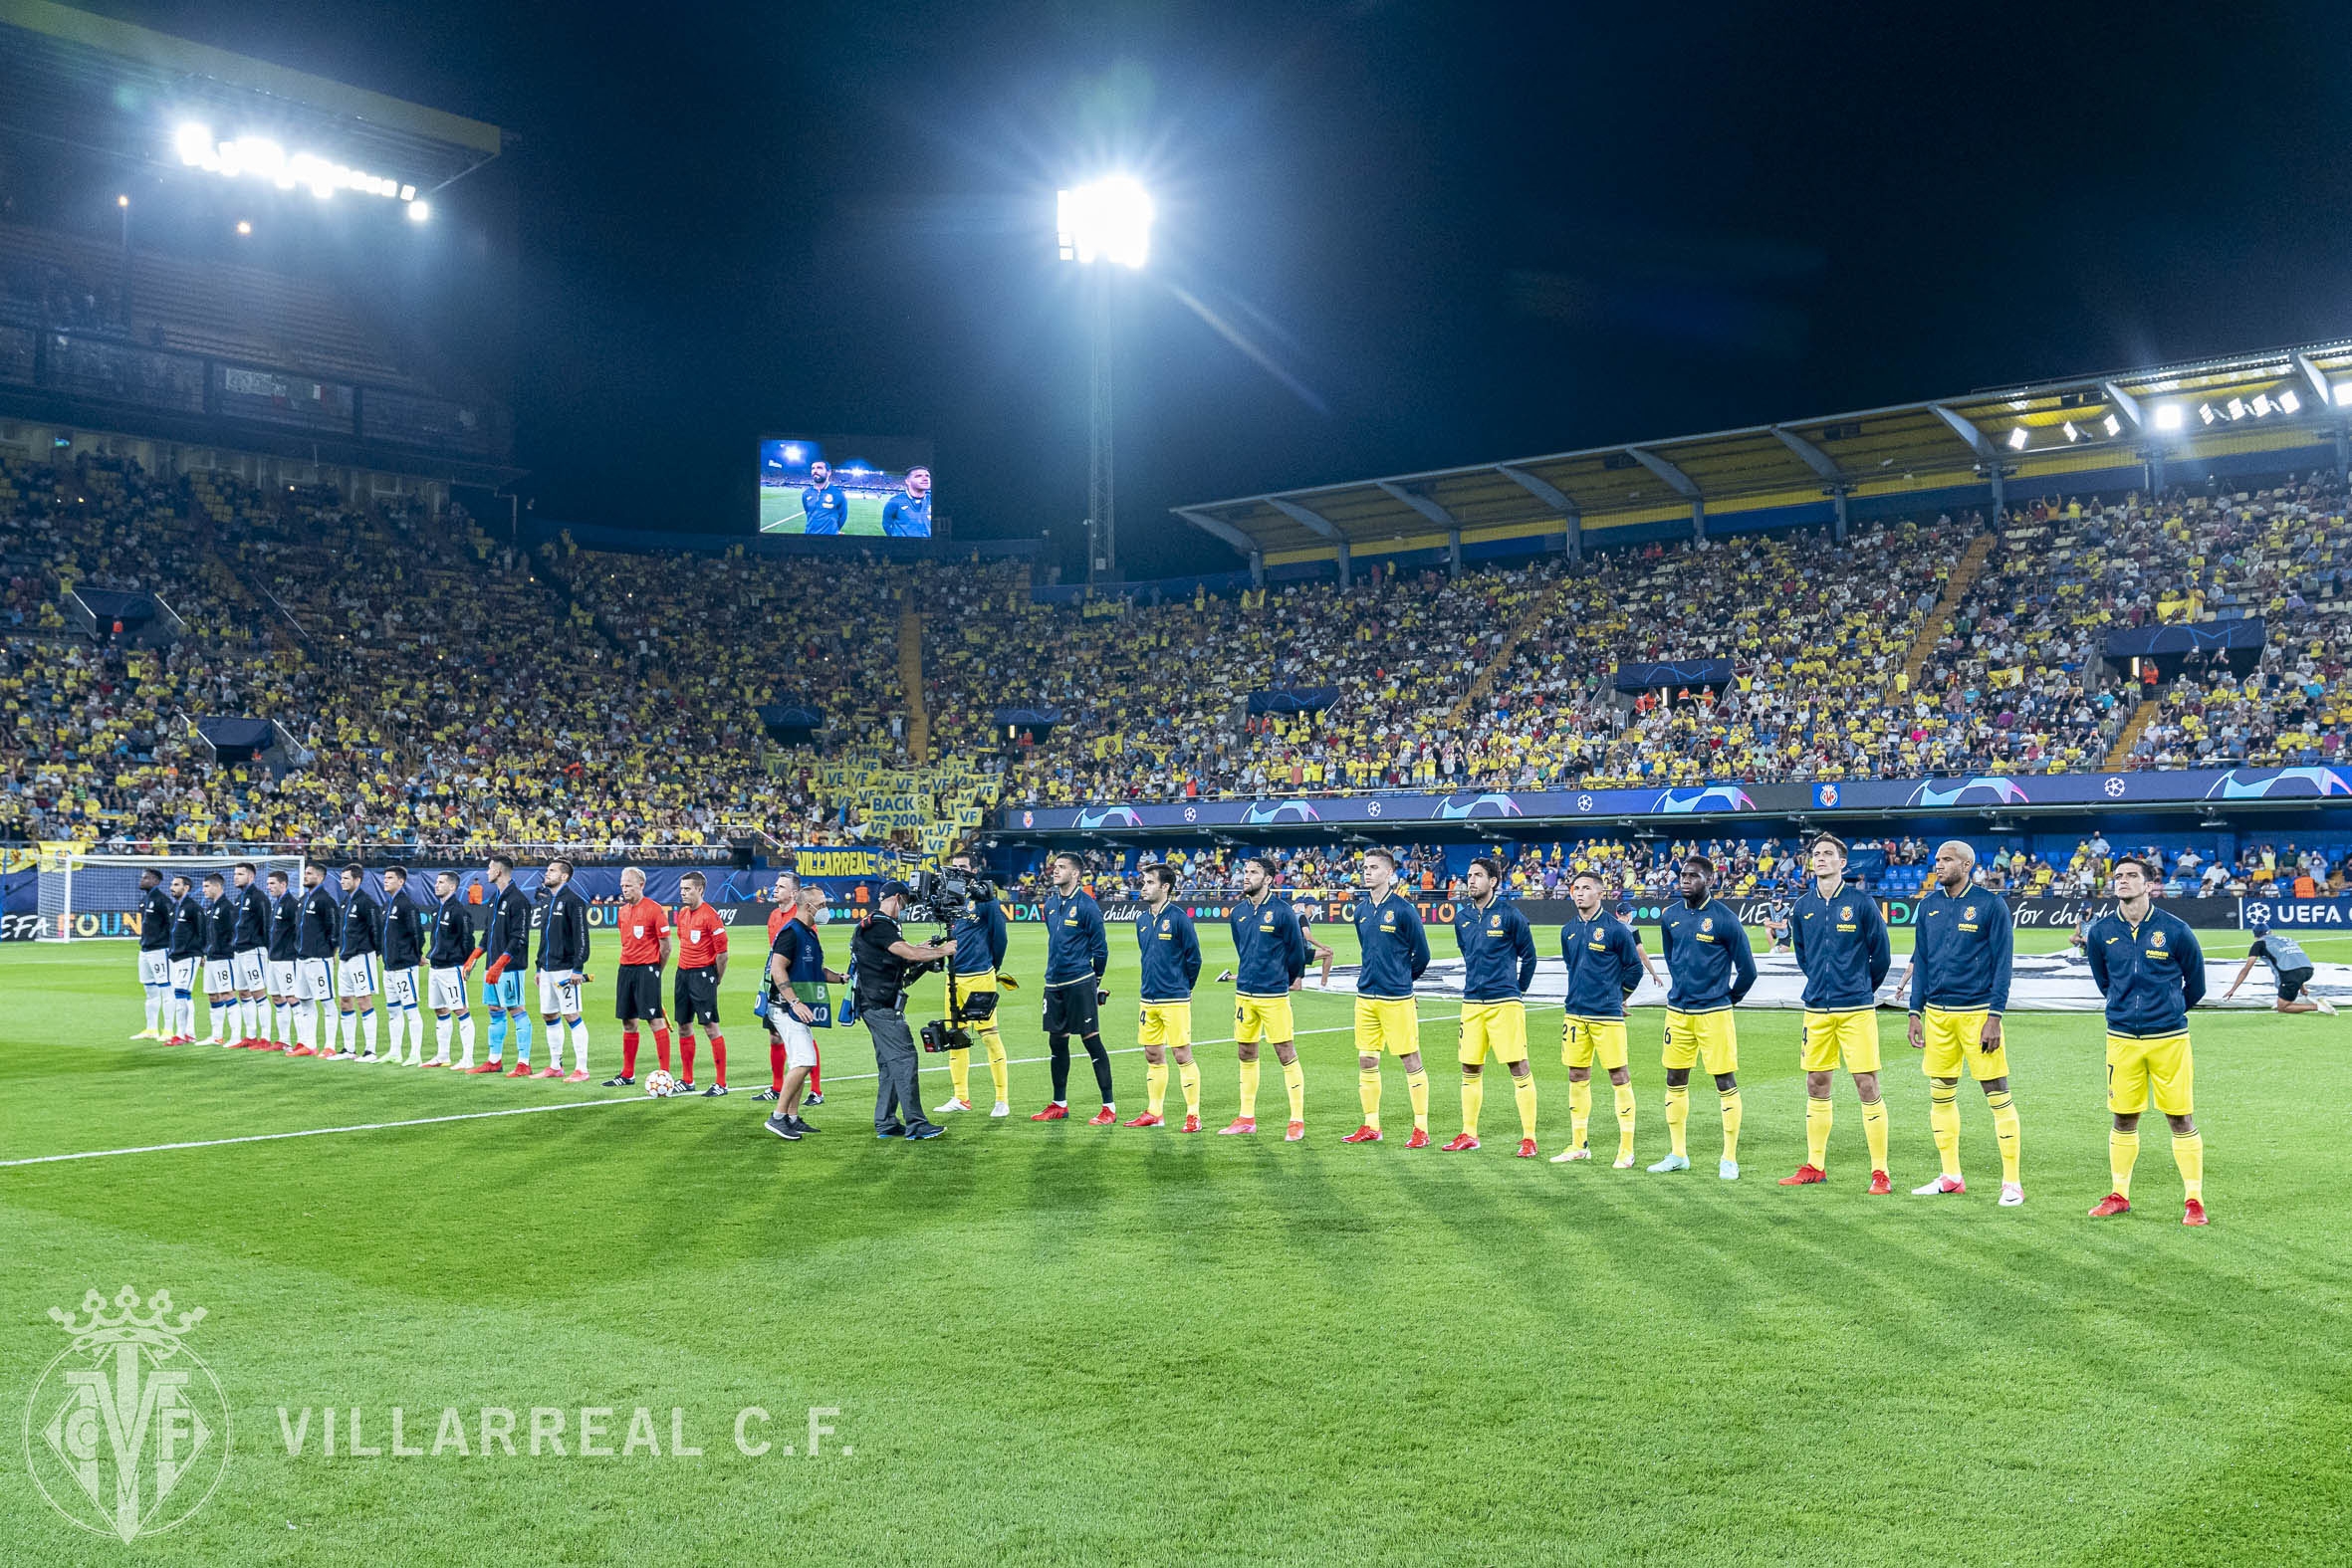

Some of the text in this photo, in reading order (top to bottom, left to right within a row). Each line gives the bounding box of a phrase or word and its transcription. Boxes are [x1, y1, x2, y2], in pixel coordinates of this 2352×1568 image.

[896, 778, 913, 789] VF
[932, 778, 949, 789] VF
[873, 796, 914, 811] BACK
[893, 813, 925, 826] 2006
[960, 810, 977, 822] VF
[870, 821, 886, 834] VF
[937, 822, 954, 835] VF
[928, 839, 945, 851] VF
[797, 850, 872, 876] VILLARREAL
[2011, 901, 2044, 929] for
[2277, 904, 2342, 924] UEFA
[154, 963, 165, 974] 91
[248, 969, 259, 981] 19
[217, 970, 229, 982] 18
[285, 973, 293, 984] 8
[318, 976, 326, 988] 6
[353, 971, 365, 984] 15
[447, 986, 459, 999] 11
[564, 984, 572, 1000] 2
[1139, 1010, 1147, 1025] 4
[1237, 1007, 1245, 1022] 4
[1562, 1023, 1576, 1043] 21
[1664, 1026, 1672, 1045] 6
[1802, 1026, 1808, 1046] 4
[2107, 1063, 2114, 1085] 7
